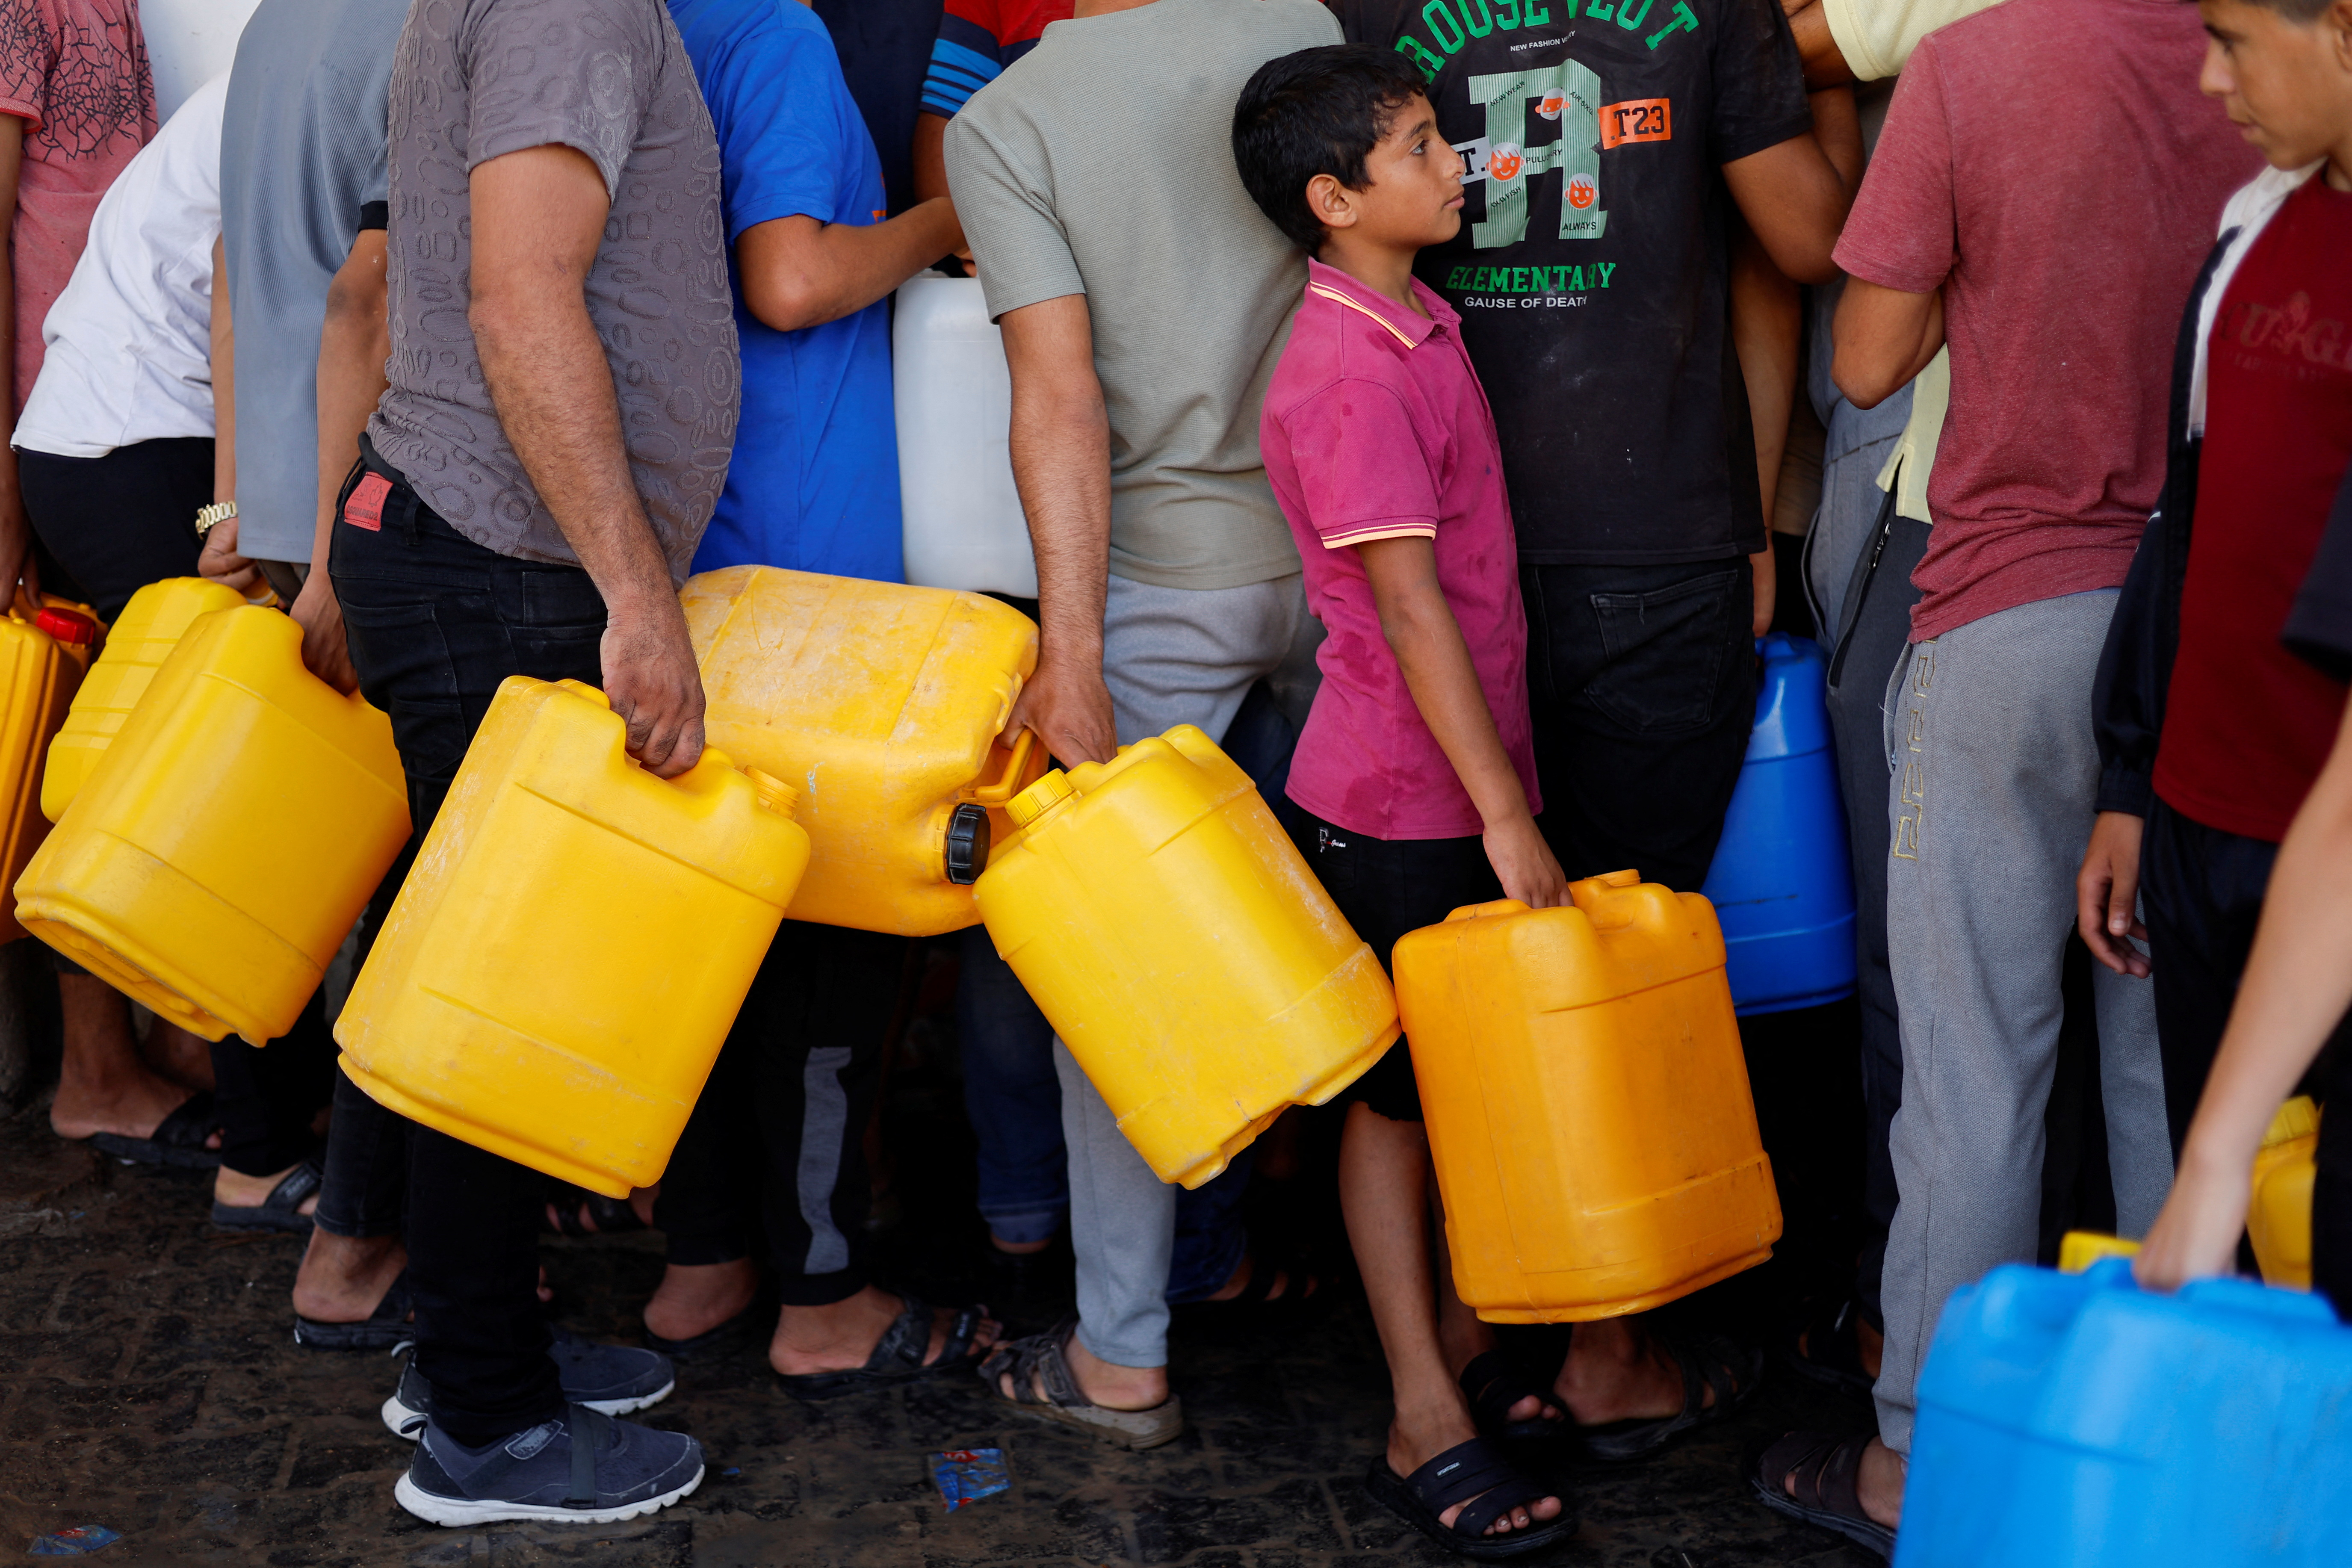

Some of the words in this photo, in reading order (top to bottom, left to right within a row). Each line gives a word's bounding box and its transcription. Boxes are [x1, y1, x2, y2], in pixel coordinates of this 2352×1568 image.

[1510, 44, 1527, 52] NEW
[1529, 38, 1560, 48] FASHION
[1490, 94, 1506, 106] NEW
[1505, 81, 1525, 96] WEAR
[1569, 92, 1581, 102] AIR
[1505, 186, 1522, 199] FISH
[1562, 221, 1596, 231] ALWAYS
[1445, 262, 1616, 293] ELEMENTARY
[1465, 296, 1516, 308] GAUSE
[1521, 298, 1542, 308] OF
[1546, 296, 1587, 307] DEATH
